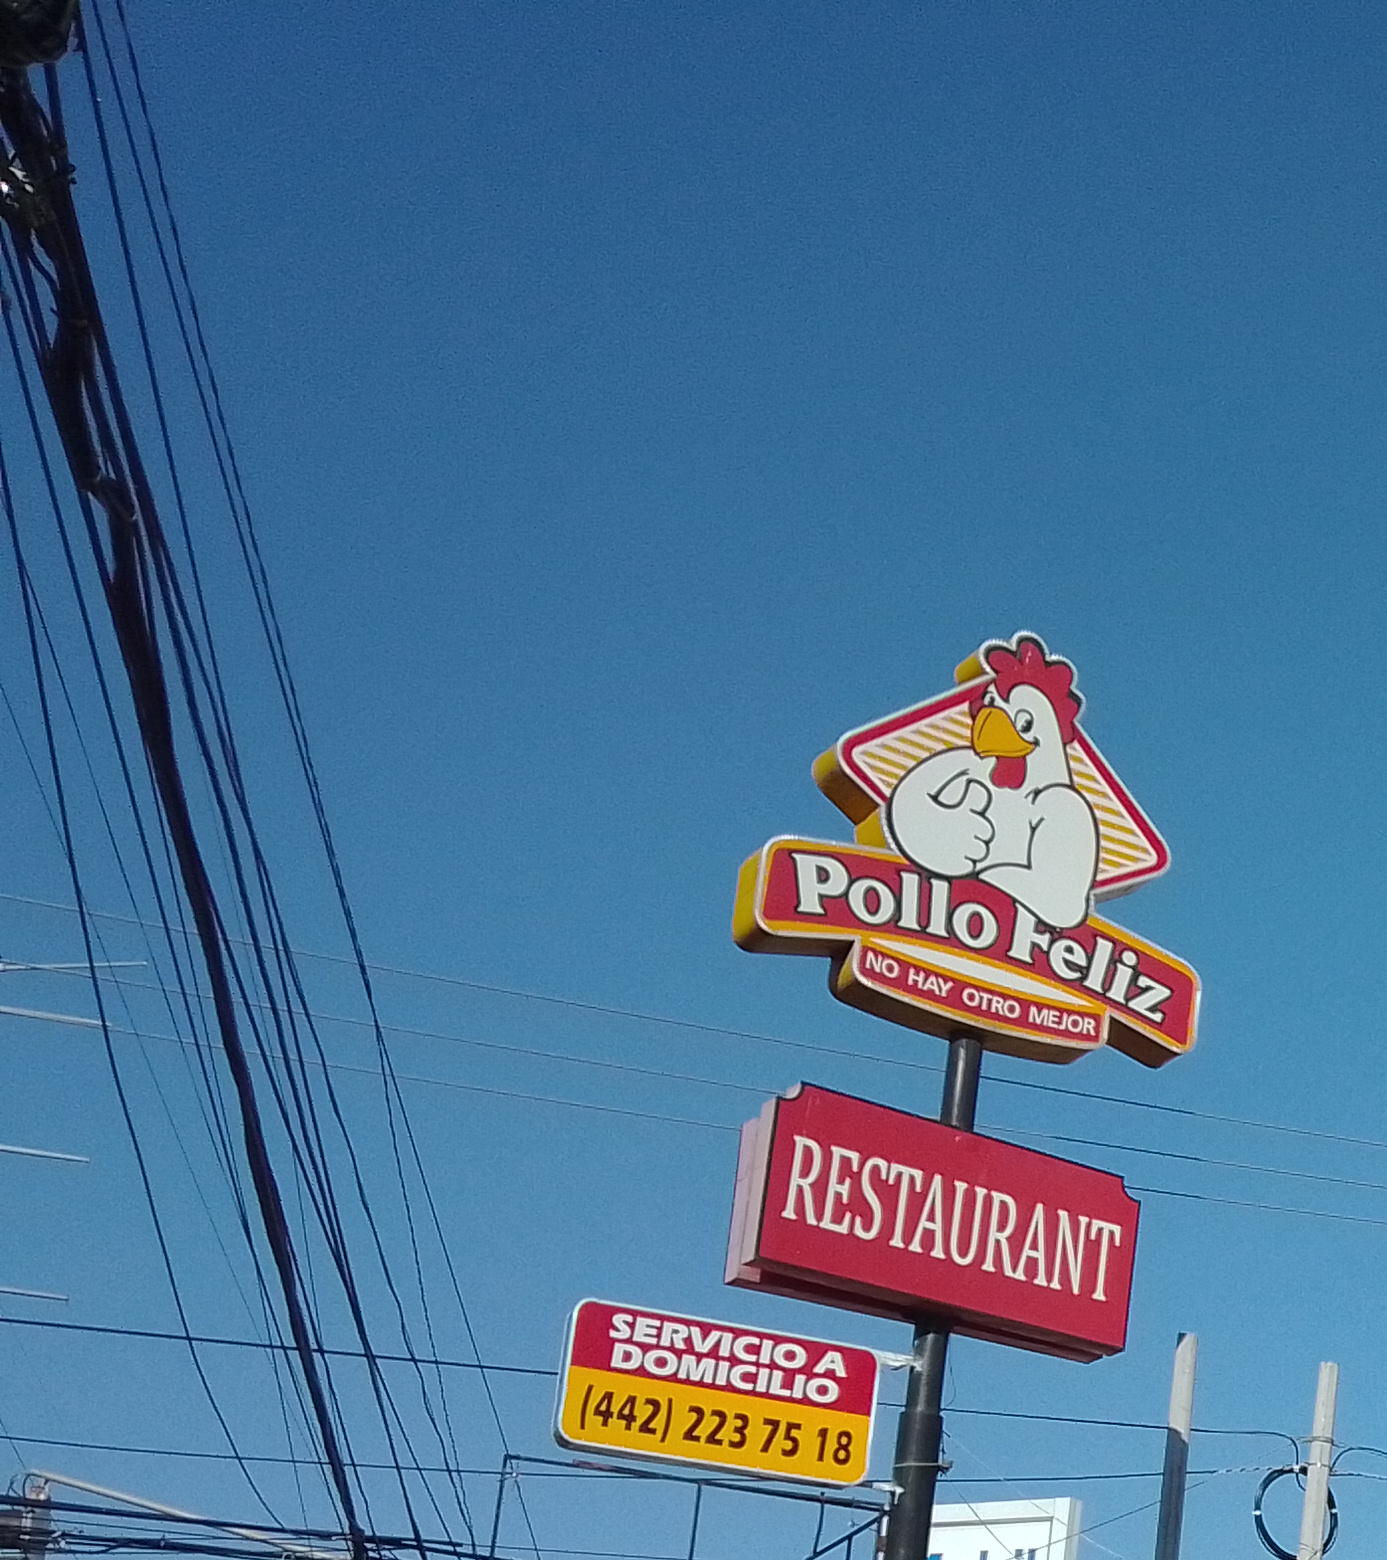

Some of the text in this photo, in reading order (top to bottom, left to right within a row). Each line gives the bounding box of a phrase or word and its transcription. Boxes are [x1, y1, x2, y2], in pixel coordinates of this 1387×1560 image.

[792, 851, 1172, 1025] Pollo Feliz
[865, 950, 1097, 1037] NO HAY OTRO MEJOR
[781, 1135, 1123, 1302] RESTAURANT
[608, 1311, 848, 1379] SERVICIO A
[610, 1341, 841, 1405] DOMICILIO
[577, 1383, 853, 1467] (442) 223 75 18
